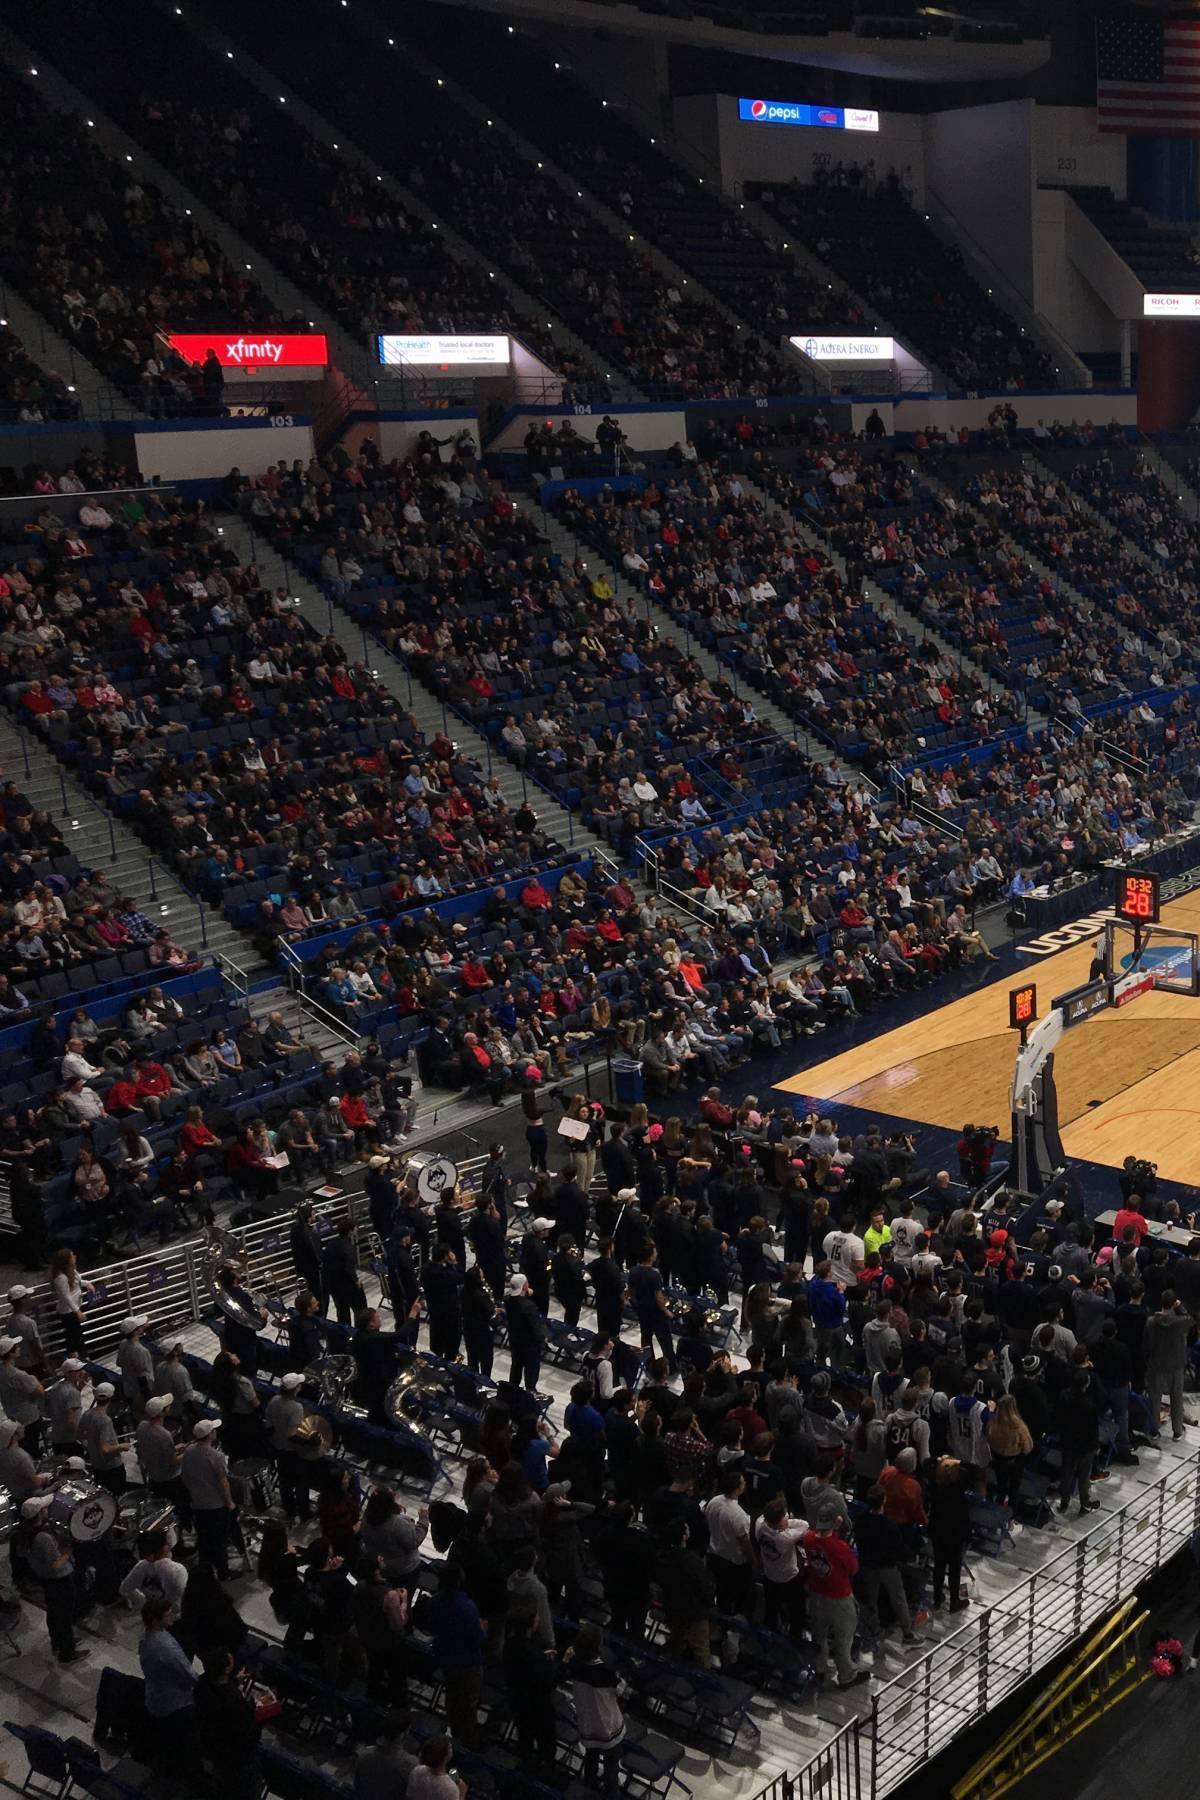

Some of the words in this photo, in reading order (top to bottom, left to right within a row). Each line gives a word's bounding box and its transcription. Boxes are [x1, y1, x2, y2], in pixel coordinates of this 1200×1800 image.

[769, 107, 800, 120] pepsi
[812, 153, 831, 165] 207
[1058, 158, 1076, 169] 231
[226, 339, 283, 363] xfinity
[849, 343, 880, 354] ENERGY
[574, 405, 591, 414] 104
[270, 416, 293, 427] 103
[1126, 877, 1153, 892] 10:32
[1125, 892, 1150, 915] 28
[1016, 990, 1033, 1003] 10:32
[1092, 998, 1106, 1008] ACURA
[1016, 1003, 1031, 1019] 28
[1073, 1008, 1088, 1018] ACURA
[831, 1244, 841, 1261] 15
[958, 1417, 970, 1437] 15
[891, 1426, 910, 1445] 34
